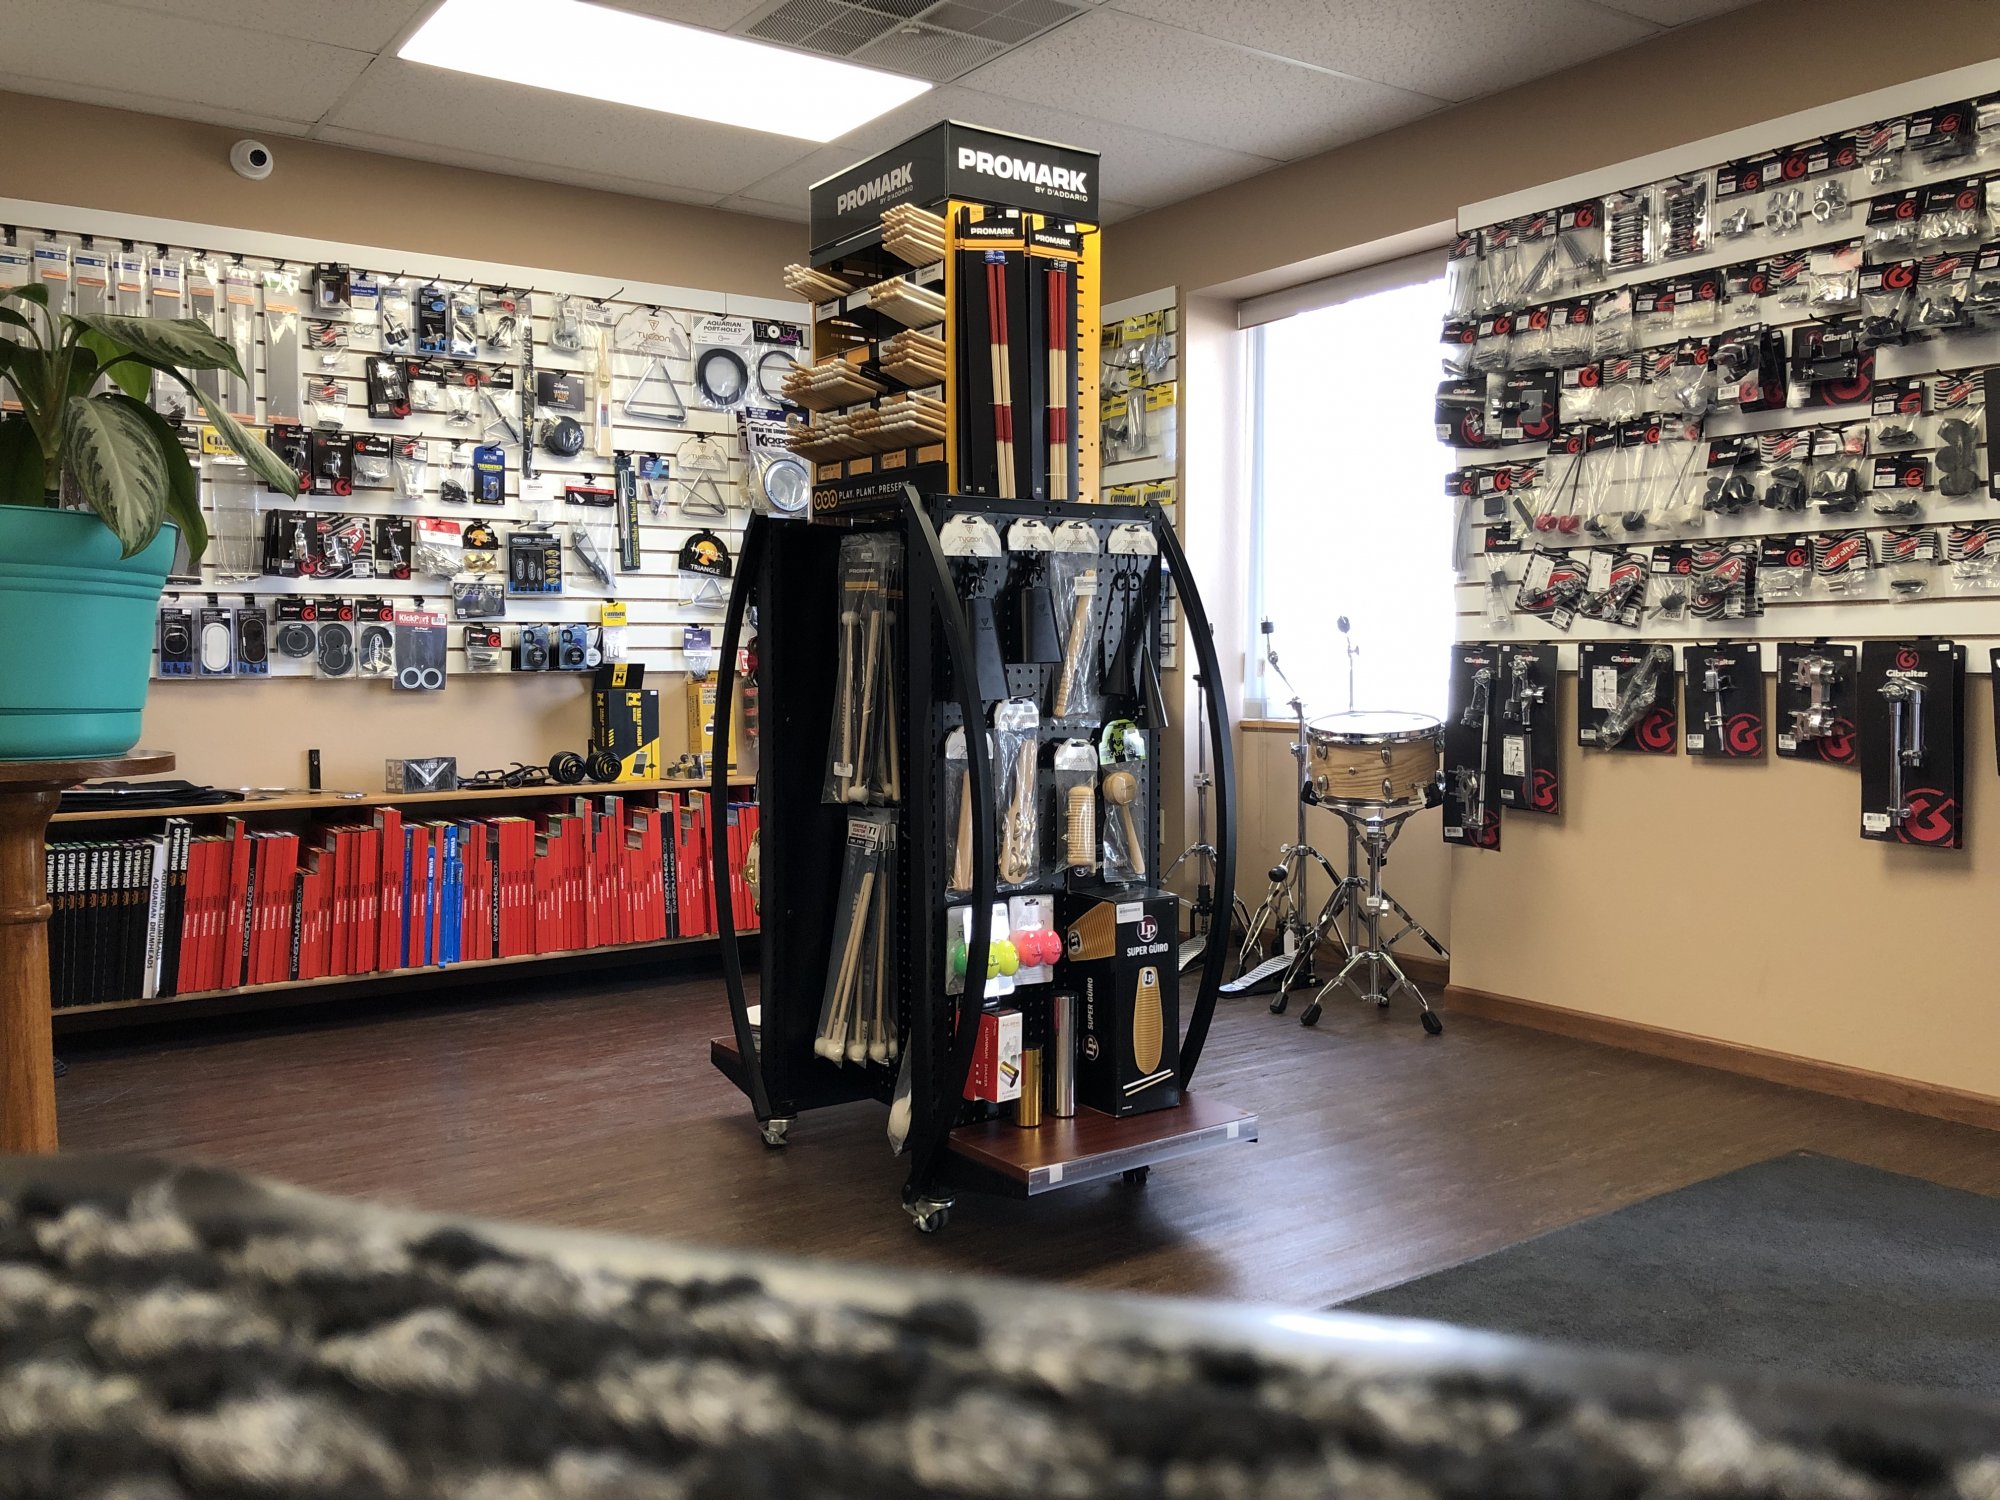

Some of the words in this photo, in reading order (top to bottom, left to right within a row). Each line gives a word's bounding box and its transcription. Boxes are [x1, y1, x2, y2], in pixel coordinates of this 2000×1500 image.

[837, 162, 913, 216] PROMARK
[958, 147, 1087, 194] PROMARK
[887, 185, 914, 201] D'ADDARIO
[1034, 186, 1045, 194] BY
[1047, 188, 1088, 202] D'ADDARIO
[970, 227, 1015, 235] PROMARK
[1035, 234, 1071, 246] PROMARK
[706, 320, 742, 328] AQUARIAN
[839, 490, 854, 500] PLAY.
[856, 487, 877, 498] PLANT.
[1824, 539, 1859, 567] Gibraltar
[1895, 538, 1919, 554] Gibraltar
[1962, 532, 1987, 550] Gibraltar
[690, 564, 720, 574] TRIANGLE
[1611, 655, 1642, 663] Gibraltar
[1886, 669, 1928, 678] Gibraltar
[142, 848, 151, 887] DRUMHEAD
[171, 828, 180, 871] DRUMHEAD
[181, 827, 190, 870] DRUMHEAD
[57, 853, 65, 893] DRUMHEAD
[68, 852, 76, 892] DRUMHEAD
[78, 852, 86, 891] DRUMHEAD
[90, 851, 98, 890] DRUMHEAD
[100, 850, 109, 890] DRUMHEAD
[112, 850, 120, 888] DRUMHEAD
[123, 850, 132, 889] DRUMHEAD
[133, 849, 141, 888] DRUMHEAD
[150, 877, 159, 918] AQUARIAN
[243, 868, 254, 956] EVANSDRUMHEADS.COM
[147, 921, 156, 969] DRUMHEADS
[292, 885, 303, 971] EVANSDRUMHEADS.COM
[1141, 921, 1156, 939] LP
[1127, 946, 1147, 957] SUPER
[1149, 942, 1169, 954] GÜIRO
